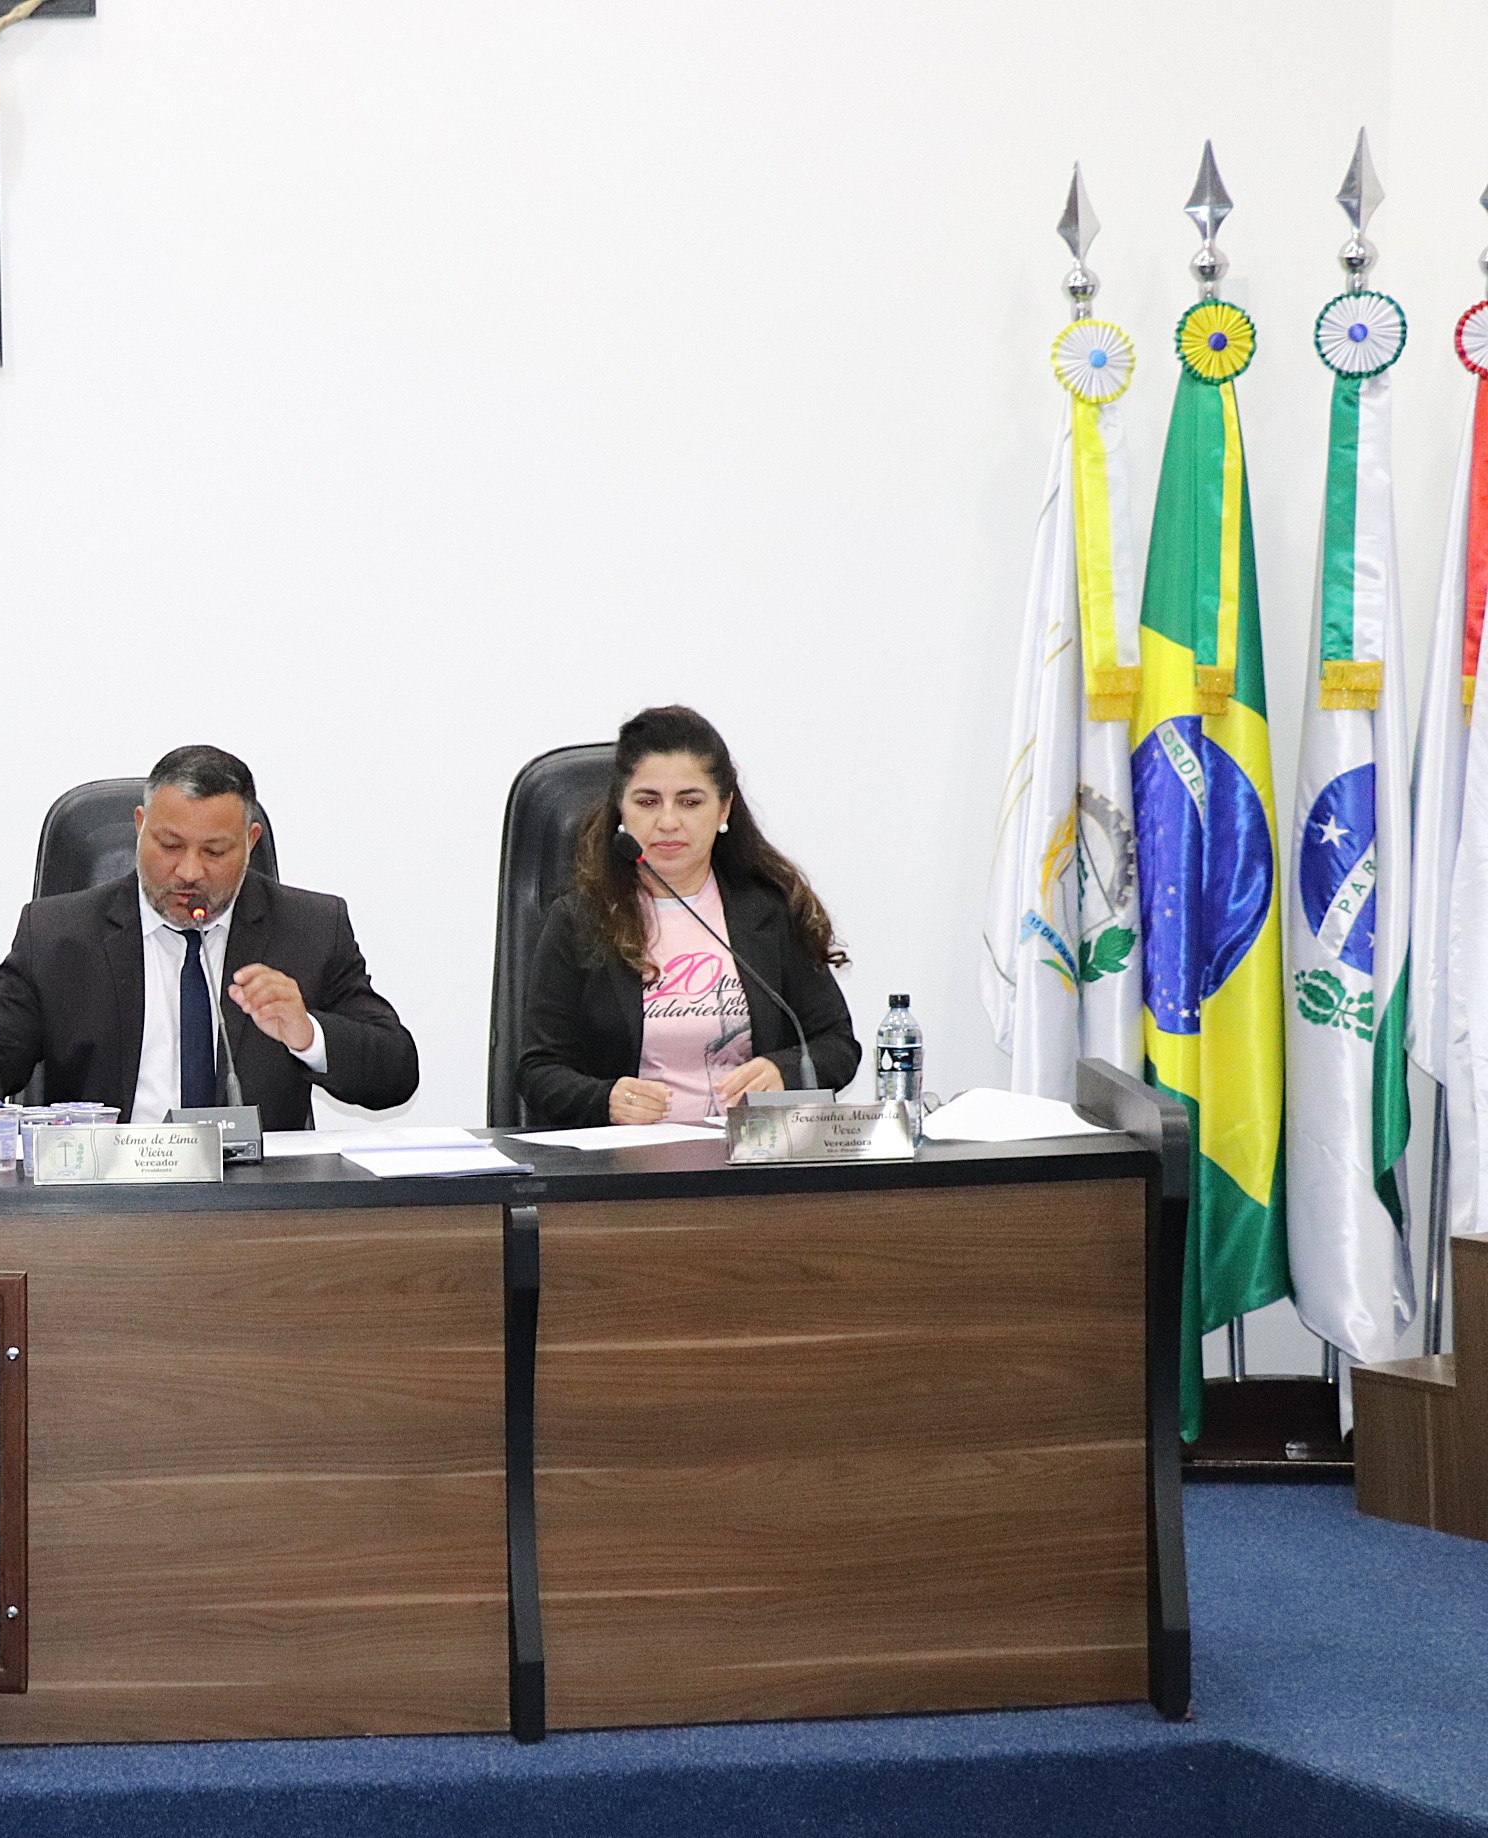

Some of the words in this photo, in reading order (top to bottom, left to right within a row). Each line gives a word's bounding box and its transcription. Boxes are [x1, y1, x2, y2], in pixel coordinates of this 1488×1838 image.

[1337, 860, 1376, 914] PAR
[643, 952, 723, 1004] 20
[792, 1110, 844, 1123] Teresinha
[113, 1133, 147, 1145] Selmo
[151, 1133, 164, 1144] de
[168, 1134, 198, 1144] Lima
[823, 1139, 872, 1147] Vereadora
[138, 1146, 174, 1158] Vieira
[134, 1159, 179, 1167] Vereador
